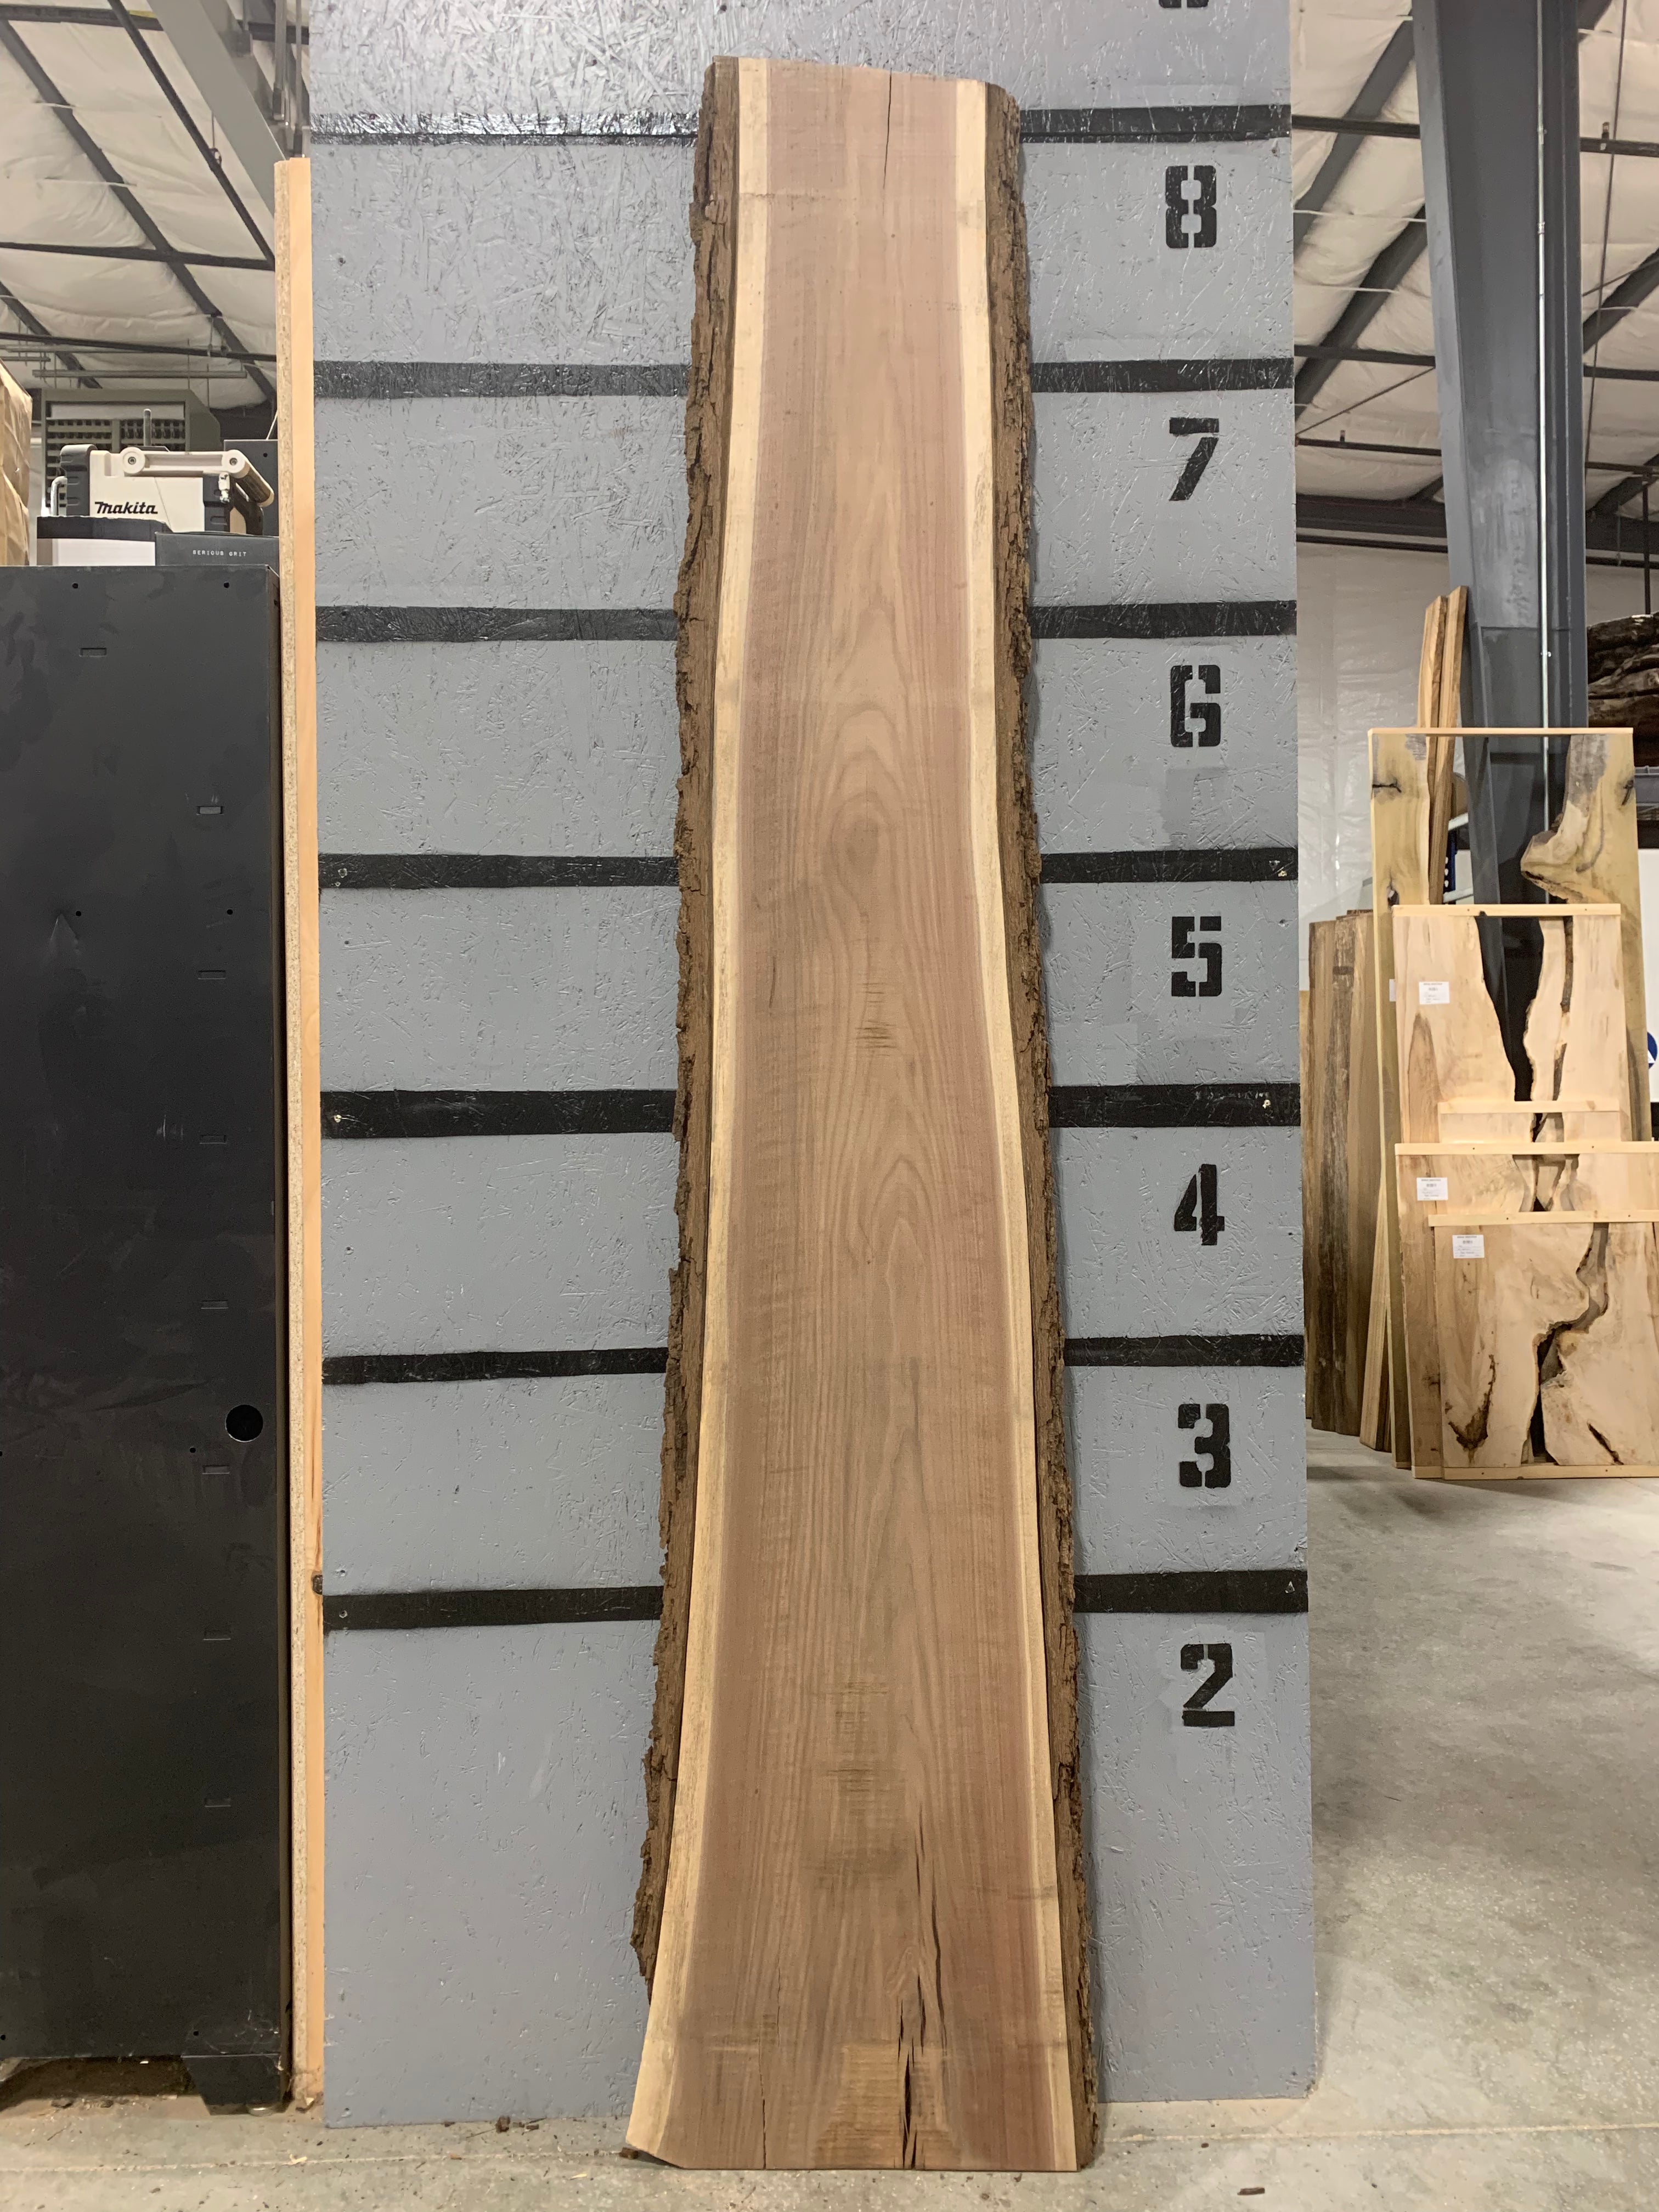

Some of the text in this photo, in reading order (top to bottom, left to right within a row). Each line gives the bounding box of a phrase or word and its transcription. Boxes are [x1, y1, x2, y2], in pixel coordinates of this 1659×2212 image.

[1165, 165, 1217, 249] 8
[1169, 417, 1219, 501] 7
[1170, 664, 1221, 748] 6
[1171, 916, 1222, 997] 5
[1173, 1163, 1225, 1246] 4
[1177, 1403, 1232, 1489] 3
[1180, 1643, 1235, 1728] 2
